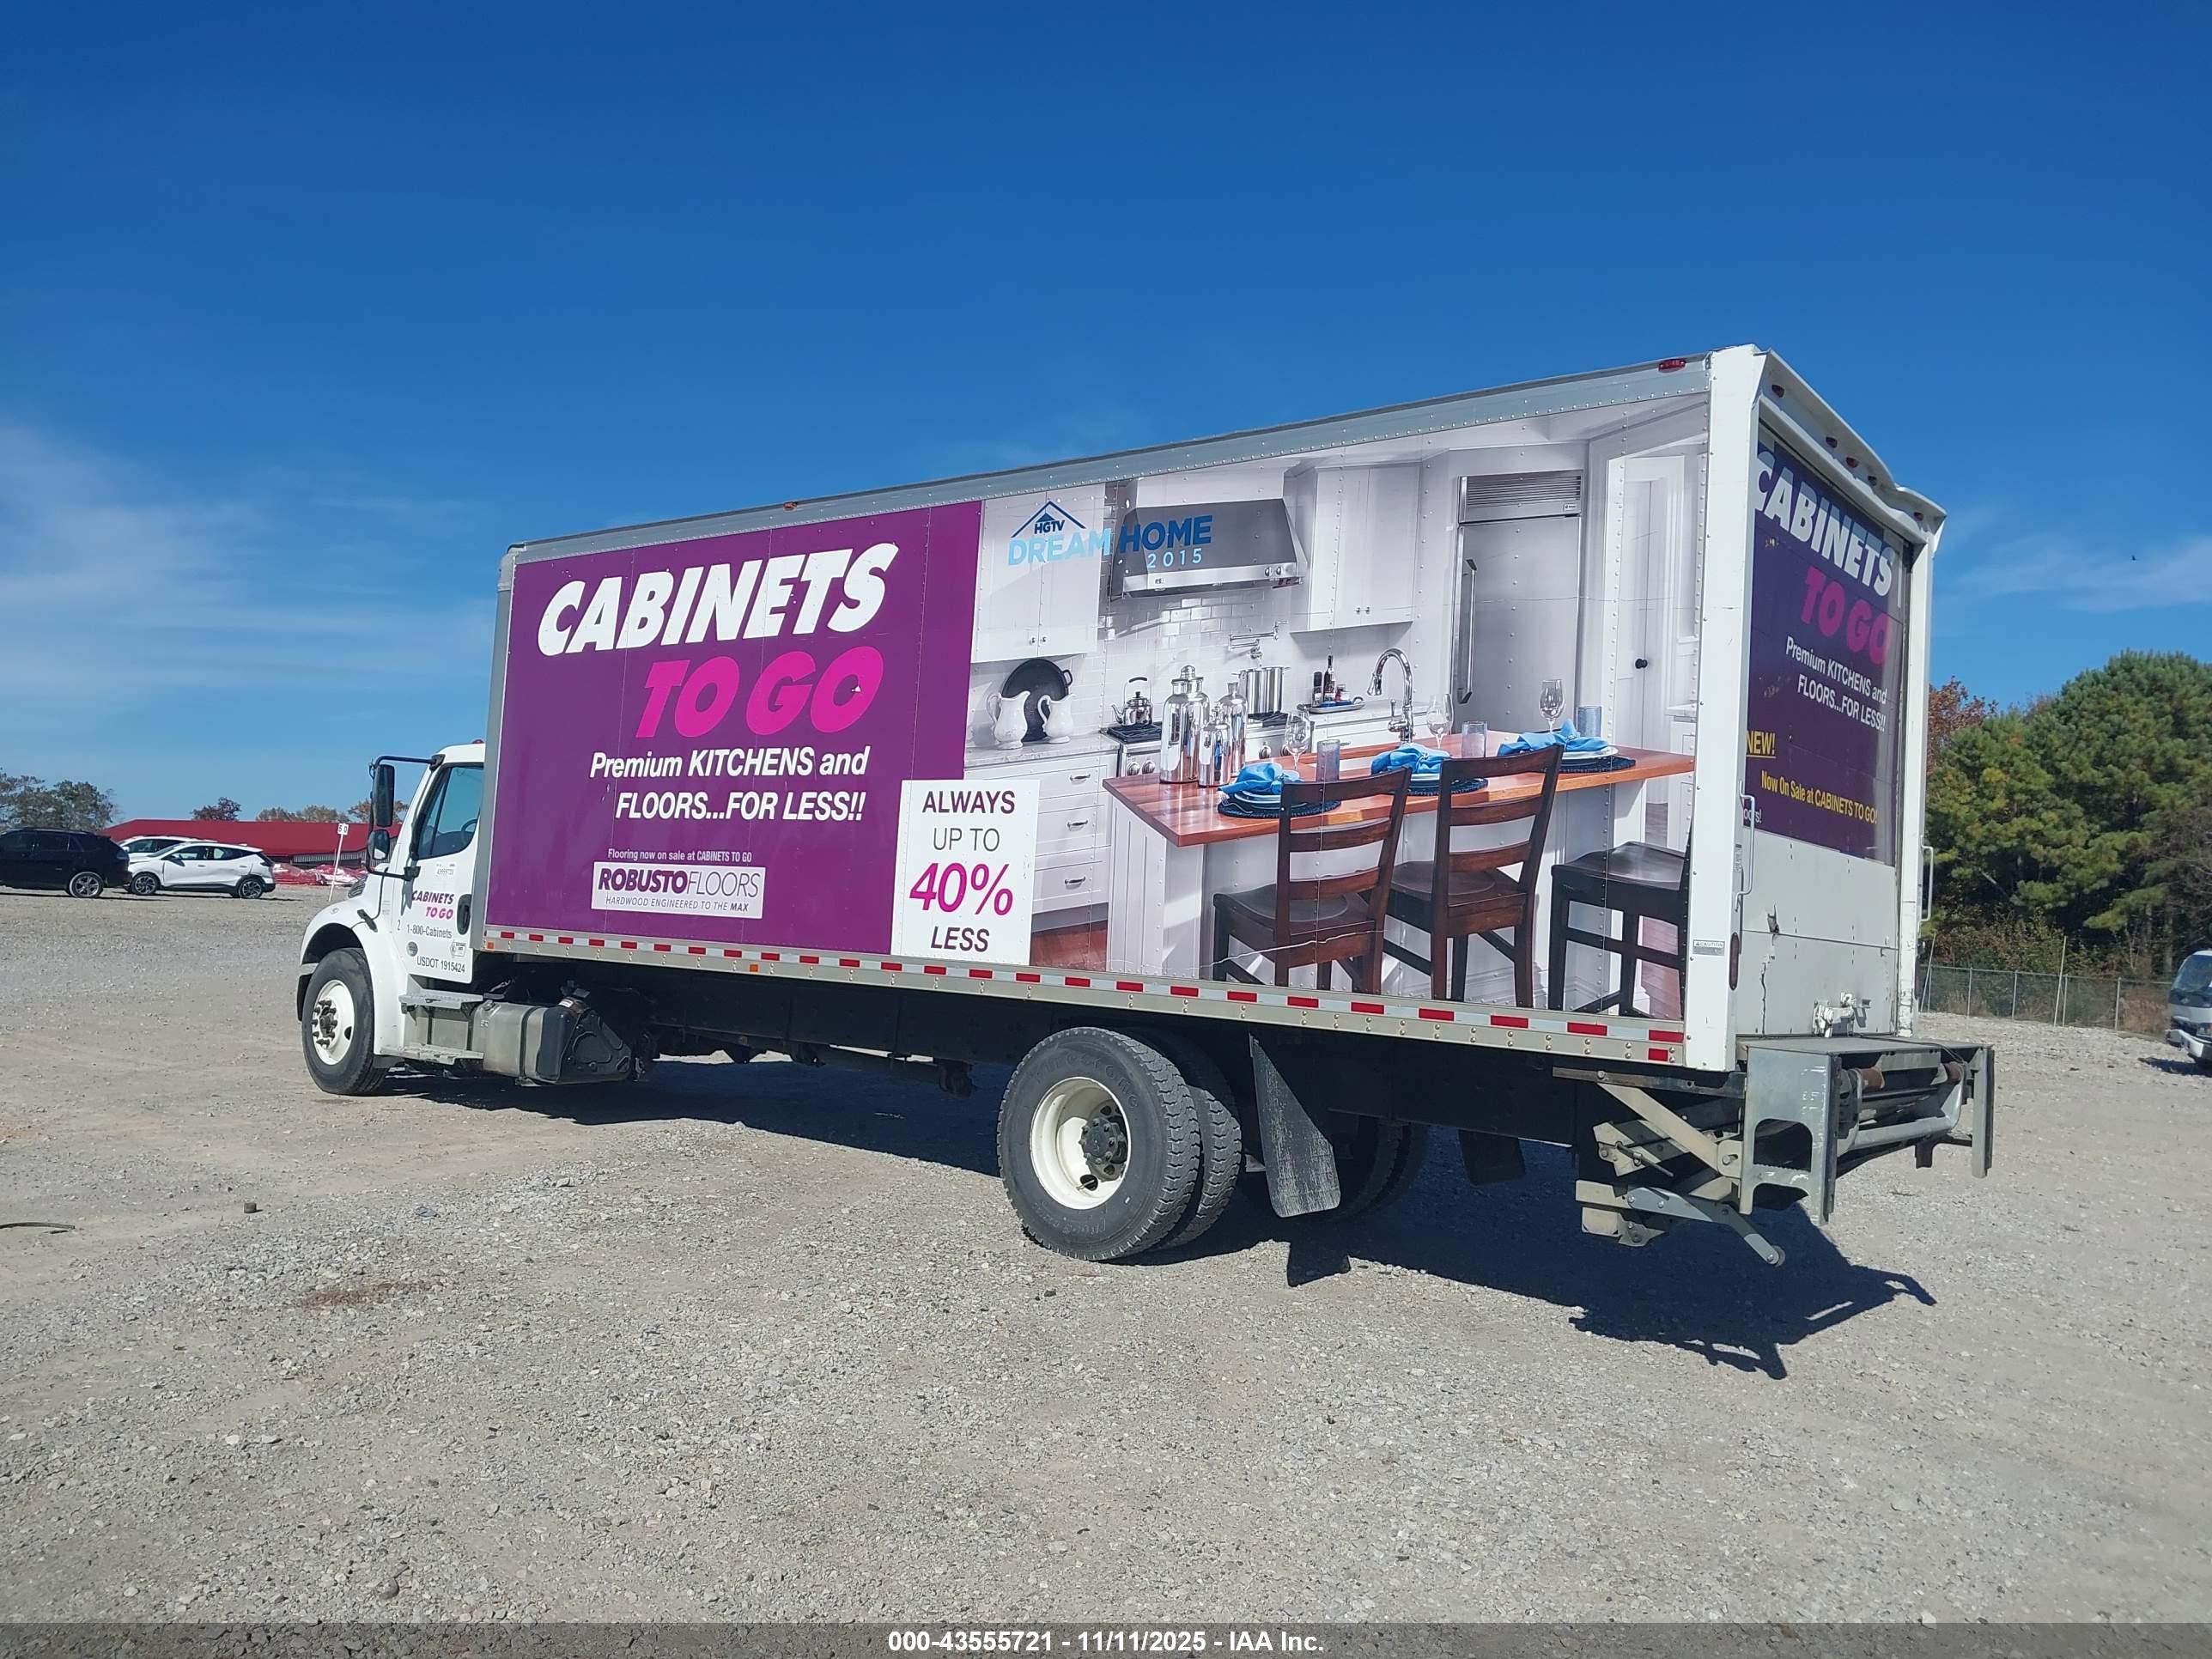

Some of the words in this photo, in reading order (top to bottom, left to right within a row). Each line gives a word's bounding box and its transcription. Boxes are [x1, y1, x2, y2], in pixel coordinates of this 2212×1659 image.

[1034, 520, 1065, 534] HGTV
[1755, 451, 1896, 596] CABINETS
[1008, 527, 1112, 565] DREAM
[1120, 515, 1212, 553] HOME
[1147, 548, 1202, 568] 2015
[538, 543, 899, 656] CABINETS
[1802, 566, 1844, 637] TO
[1847, 599, 1892, 664] GO
[1786, 635, 1826, 674] Premium
[1827, 659, 1872, 696] KITCHENS
[1872, 687, 1887, 704] and
[635, 656, 739, 738] TO
[746, 646, 884, 735] GO
[1861, 705, 1886, 732] LESS!!
[1746, 731, 1776, 756] NEW!
[590, 751, 682, 777] Premium
[688, 747, 814, 776] KITCHENS
[819, 746, 871, 775] and
[782, 791, 866, 821] LESS!!
[922, 790, 1015, 814] ALWAYS
[1761, 770, 1778, 793] Now
[1779, 776, 1789, 797] On
[1790, 781, 1805, 801] Sale
[1807, 788, 1814, 804] at
[1814, 790, 1853, 817] CABINETS
[1855, 802, 1864, 819] TO
[1865, 806, 1878, 824] GO!
[933, 828, 962, 850] UP
[969, 828, 1000, 852] TO
[608, 848, 638, 860] Flooring
[657, 852, 666, 860] on
[669, 850, 685, 860] sale
[687, 850, 696, 860] at
[696, 850, 730, 861] CABINETS
[732, 851, 741, 862] TO
[742, 852, 752, 862] GO
[412, 890, 454, 904] CABINETS
[909, 863, 1013, 915] 40%
[426, 907, 438, 917] TO
[439, 908, 453, 920] GO
[606, 896, 648, 906] HARDWOOD
[651, 898, 698, 908] ENGINEERED
[701, 901, 710, 909] TO
[714, 902, 728, 910] THE
[730, 902, 749, 911] MAX
[931, 926, 989, 952] LESS
[417, 956, 439, 969] USDOT
[441, 960, 465, 973] 1915424
